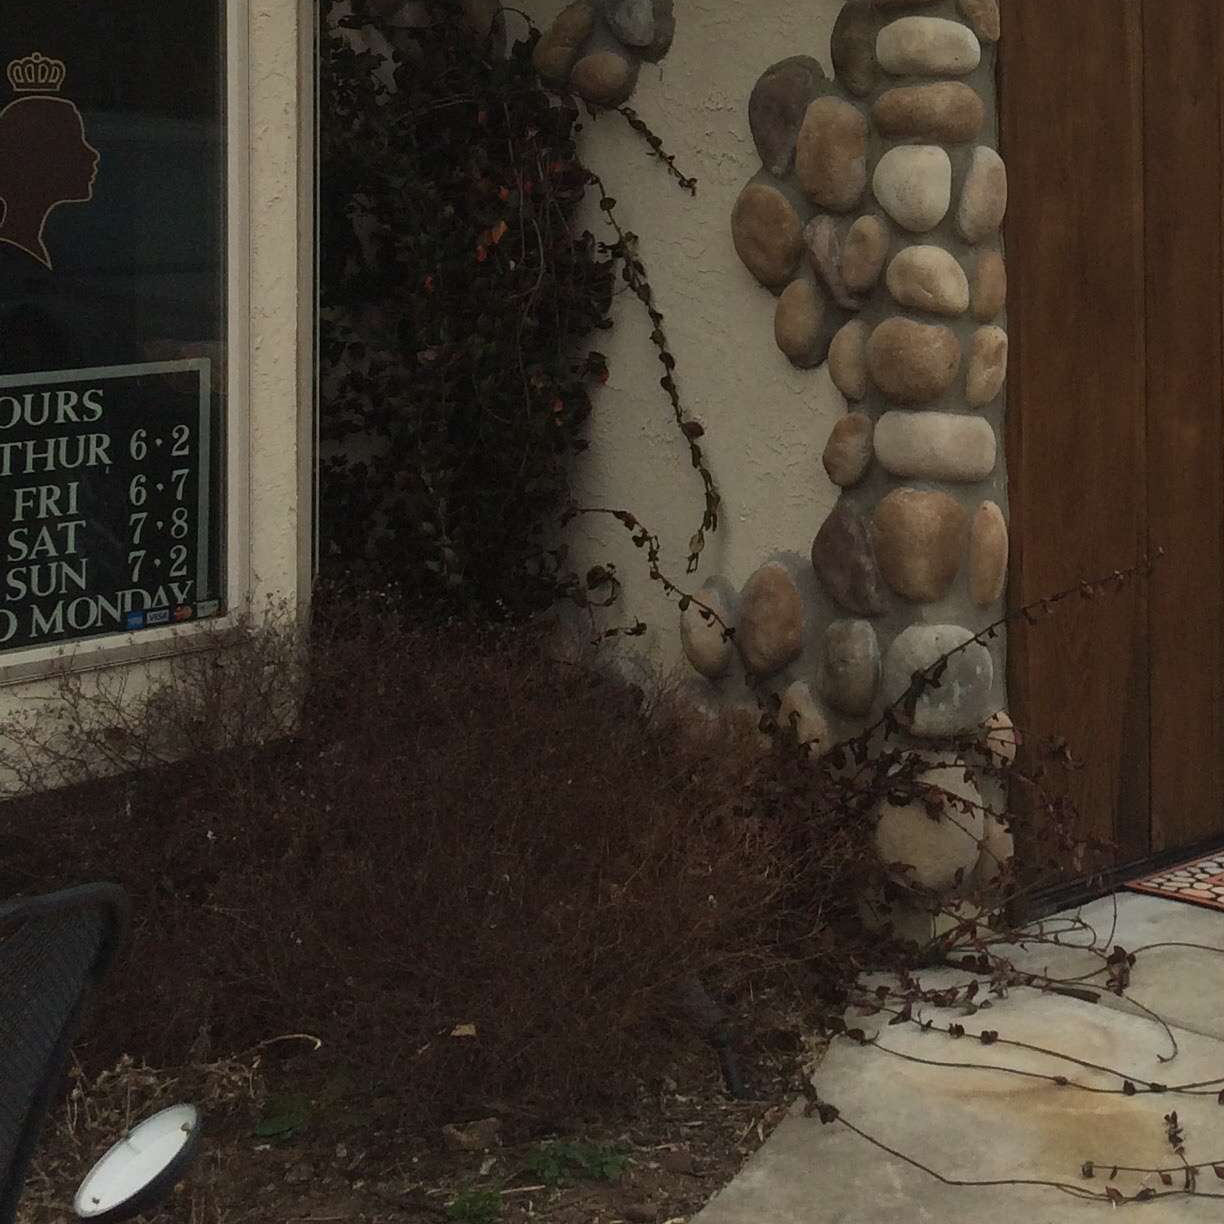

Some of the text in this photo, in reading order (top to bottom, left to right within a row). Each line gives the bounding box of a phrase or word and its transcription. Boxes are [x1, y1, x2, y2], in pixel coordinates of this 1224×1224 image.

[0, 389, 104, 430] OURS
[0, 433, 112, 476] THUR
[12, 481, 80, 522] FRI
[7, 520, 86, 562] SAT
[6, 558, 88, 601] SUN
[30, 580, 194, 638] MONDAY
